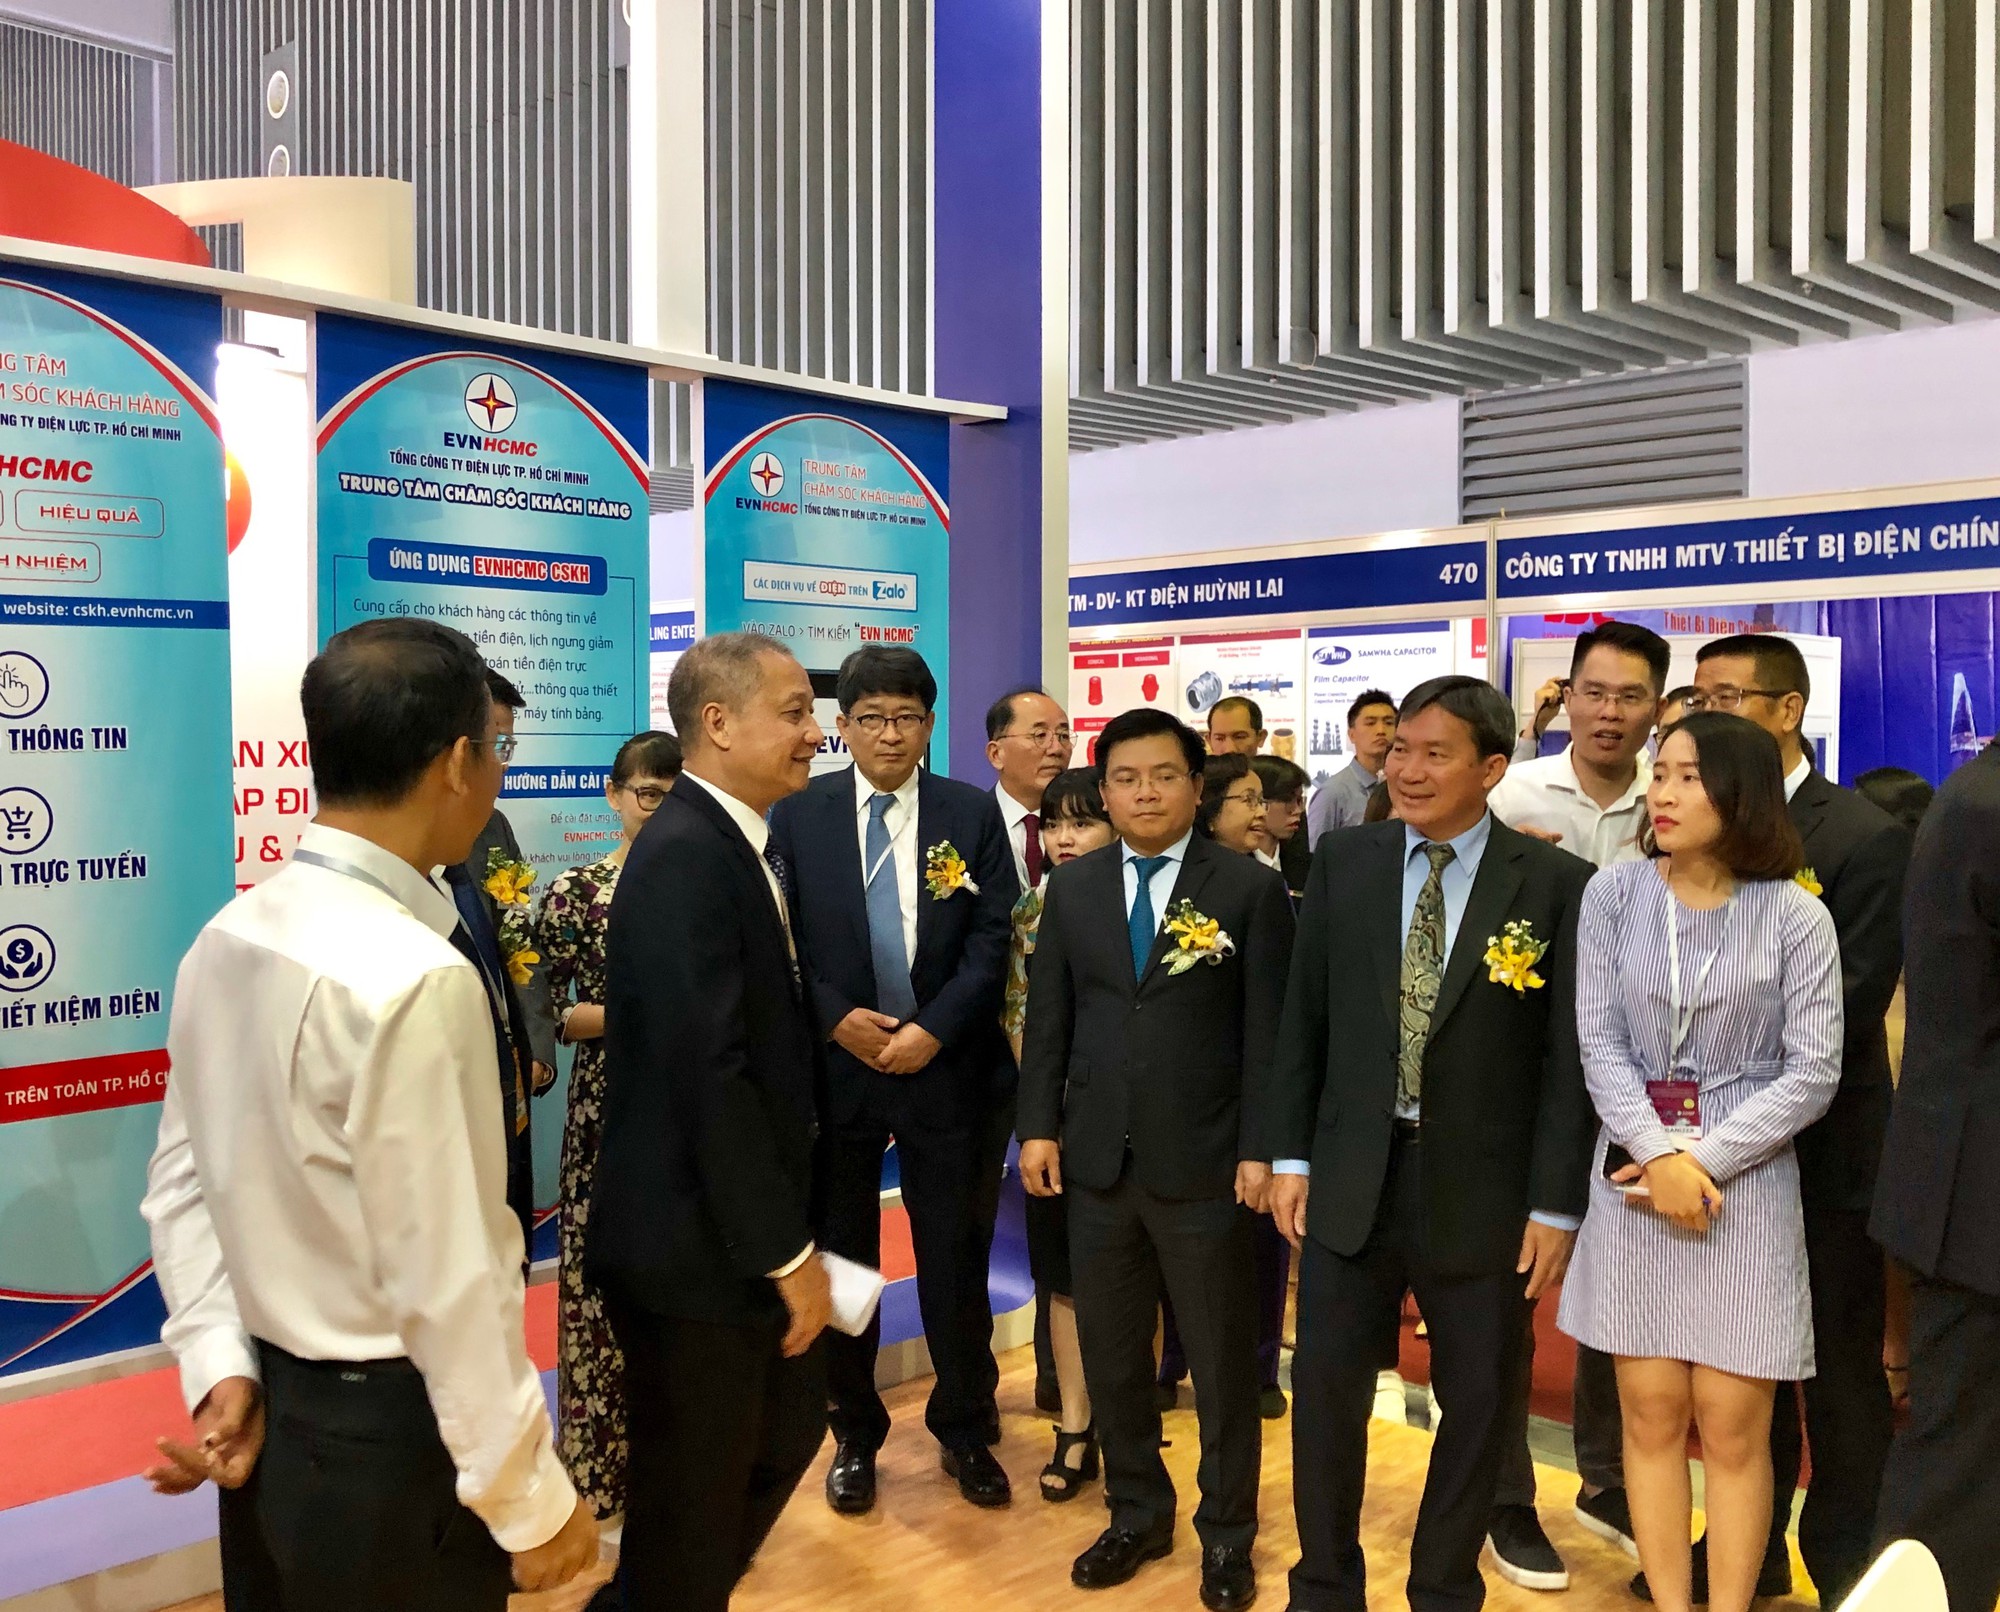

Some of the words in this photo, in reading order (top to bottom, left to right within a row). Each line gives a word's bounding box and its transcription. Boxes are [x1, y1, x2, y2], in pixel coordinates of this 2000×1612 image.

[23, 353, 66, 376] TÂM
[12, 382, 50, 404] SÓC
[57, 387, 122, 411] KHÁCH
[128, 393, 179, 417] HÀNG
[20, 415, 34, 428] TY
[38, 415, 65, 433] ĐIỆN
[69, 420, 91, 435] LỰC
[94, 422, 109, 435] TP.
[131, 424, 149, 438] CHÍ
[152, 427, 182, 442] MINH
[443, 431, 539, 458] EVNHCMC
[389, 447, 417, 466] TỔNG
[420, 453, 449, 470] CÔNG
[451, 458, 463, 471] TY
[466, 459, 490, 476] ĐIỆN
[492, 463, 511, 479] LỰC
[514, 465, 527, 479] TP.
[545, 467, 561, 482] CHÍ
[564, 471, 589, 485] MINH
[804, 460, 841, 477] TRUNG
[844, 461, 867, 480] TÂM
[340, 473, 401, 496] TRUNG
[404, 479, 440, 500] TÂM
[444, 484, 492, 505] CHĂM
[496, 488, 527, 508] SÓC
[531, 494, 583, 514] KHÁCH
[587, 498, 631, 519] HÀNG
[735, 497, 799, 515] EVNHCMC
[804, 482, 835, 497] CHĂM
[837, 484, 857, 500] SÓC
[861, 487, 895, 504] KHÁCH
[898, 491, 926, 509] HÀNG
[40, 503, 91, 523] HIỆU
[96, 507, 141, 524] QUẢ
[822, 506, 840, 517] CÔNG
[842, 509, 849, 518] TY
[910, 516, 927, 526] MINH
[1505, 551, 1564, 580] CÔNG
[1569, 552, 1598, 576] TY
[1605, 547, 1667, 573] TNHH
[1675, 542, 1727, 569] MTV
[1733, 526, 1809, 565] THIẾT
[1818, 533, 1845, 563] BỊ
[1853, 522, 1921, 560] ĐIỆN
[1930, 515, 2000, 551] CHÍN
[16, 553, 88, 573] NHIỆM
[389, 547, 423, 571] ỨNG
[427, 553, 470, 576] DỤNG
[474, 556, 547, 580] EVNHCMC
[551, 563, 589, 583] CSKH
[753, 577, 769, 589] CÁC
[770, 579, 790, 592] DỊCH
[793, 581, 804, 592] VỤ
[819, 580, 846, 597] ĐIỆN
[848, 583, 869, 596] TRÊN
[872, 580, 906, 601] Zalo
[1126, 589, 1146, 608] KT
[1150, 582, 1188, 609] ĐIỆN
[1193, 577, 1250, 603] HUỲNH
[1255, 577, 1284, 598] LAI
[1439, 562, 1478, 584] 470
[3, 601, 69, 616] website:
[73, 604, 194, 620] cskh.evnhcmc.vn
[353, 598, 385, 616] Cung
[389, 599, 410, 617] cấp
[413, 602, 435, 616] cho
[438, 603, 473, 618] khách
[476, 605, 505, 622] hàng
[508, 607, 527, 621] các
[531, 609, 563, 625] thông
[566, 612, 581, 624] tin
[583, 611, 597, 625] về
[473, 629, 496, 644] tiền
[499, 632, 526, 647] điện,
[529, 633, 549, 648] lịch
[588, 635, 614, 651] giảm
[671, 624, 695, 639] ENTE
[768, 623, 796, 637] ZALO
[808, 625, 825, 639] TÌM
[828, 623, 851, 640] KIẾM
[513, 655, 535, 670] tiền
[538, 657, 562, 673] điện
[565, 659, 588, 672] trực
[1358, 648, 1392, 658] SAMWHA
[1394, 647, 1437, 657] CAPACITOR
[569, 686, 590, 698] qua
[593, 683, 618, 697] thiết
[1314, 675, 1330, 684] Film
[1332, 674, 1370, 685] Capacitor
[524, 706, 548, 722] máy
[551, 706, 573, 720] tính
[575, 707, 604, 723] bảng.
[8, 724, 84, 751] THÔNG
[91, 727, 127, 749] TIN
[504, 771, 547, 790] HƯỚNG
[551, 769, 576, 790] DẪN
[580, 771, 600, 790] CÀI
[10, 858, 70, 889] TRỰC
[77, 849, 147, 881] TUYẾN
[0, 997, 37, 1029] IẾT
[45, 995, 101, 1026] KIỆM
[109, 988, 160, 1019] ĐIỆN
[5, 1086, 49, 1106] TRÊN
[54, 1079, 98, 1099] TOÀN
[103, 1077, 124, 1093] TP.
[128, 1069, 151, 1089] HỒ
